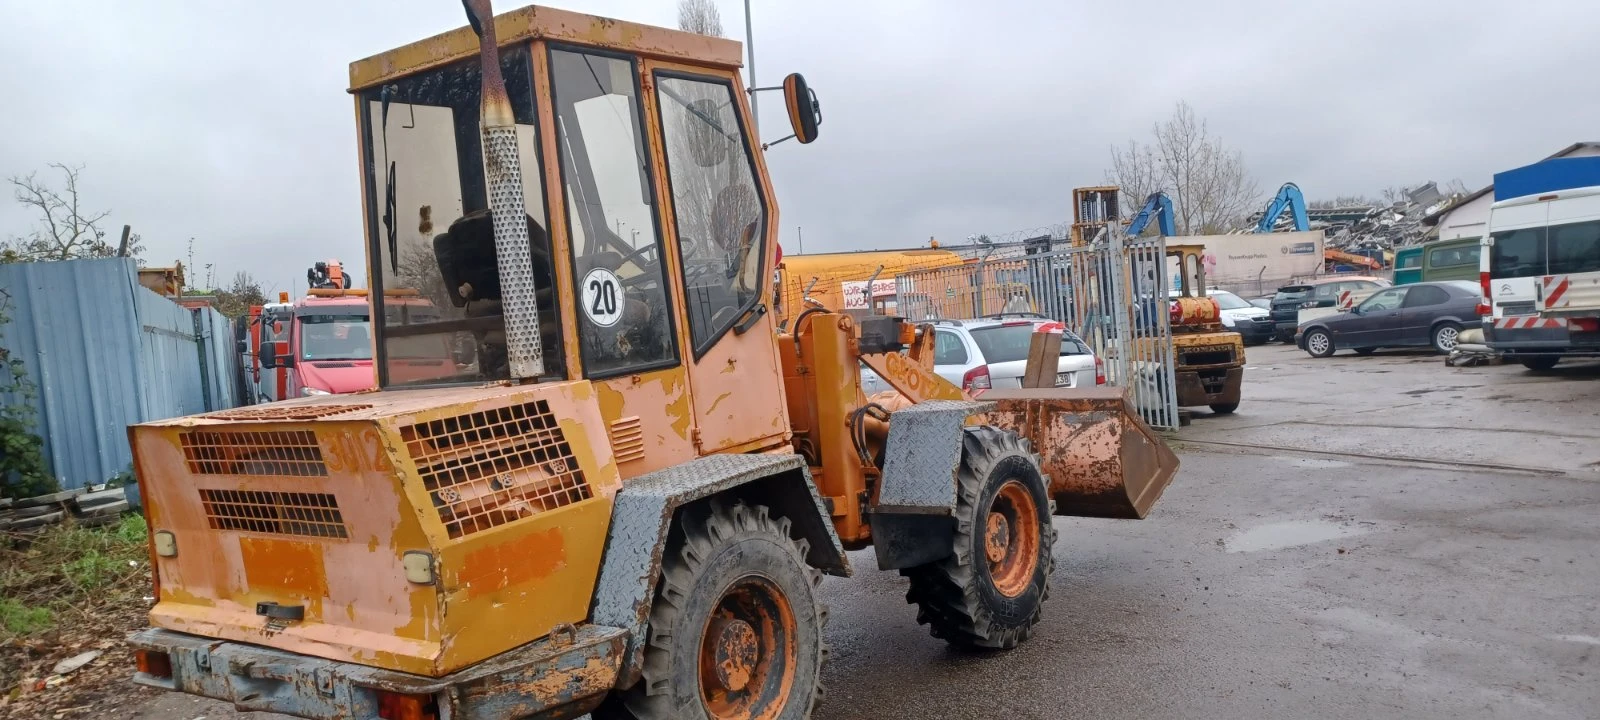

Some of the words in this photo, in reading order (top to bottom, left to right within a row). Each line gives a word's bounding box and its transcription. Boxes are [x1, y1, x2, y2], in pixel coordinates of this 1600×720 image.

[589, 279, 617, 315] 20
[844, 286, 861, 296] WIR
[863, 282, 896, 293] EHRE
